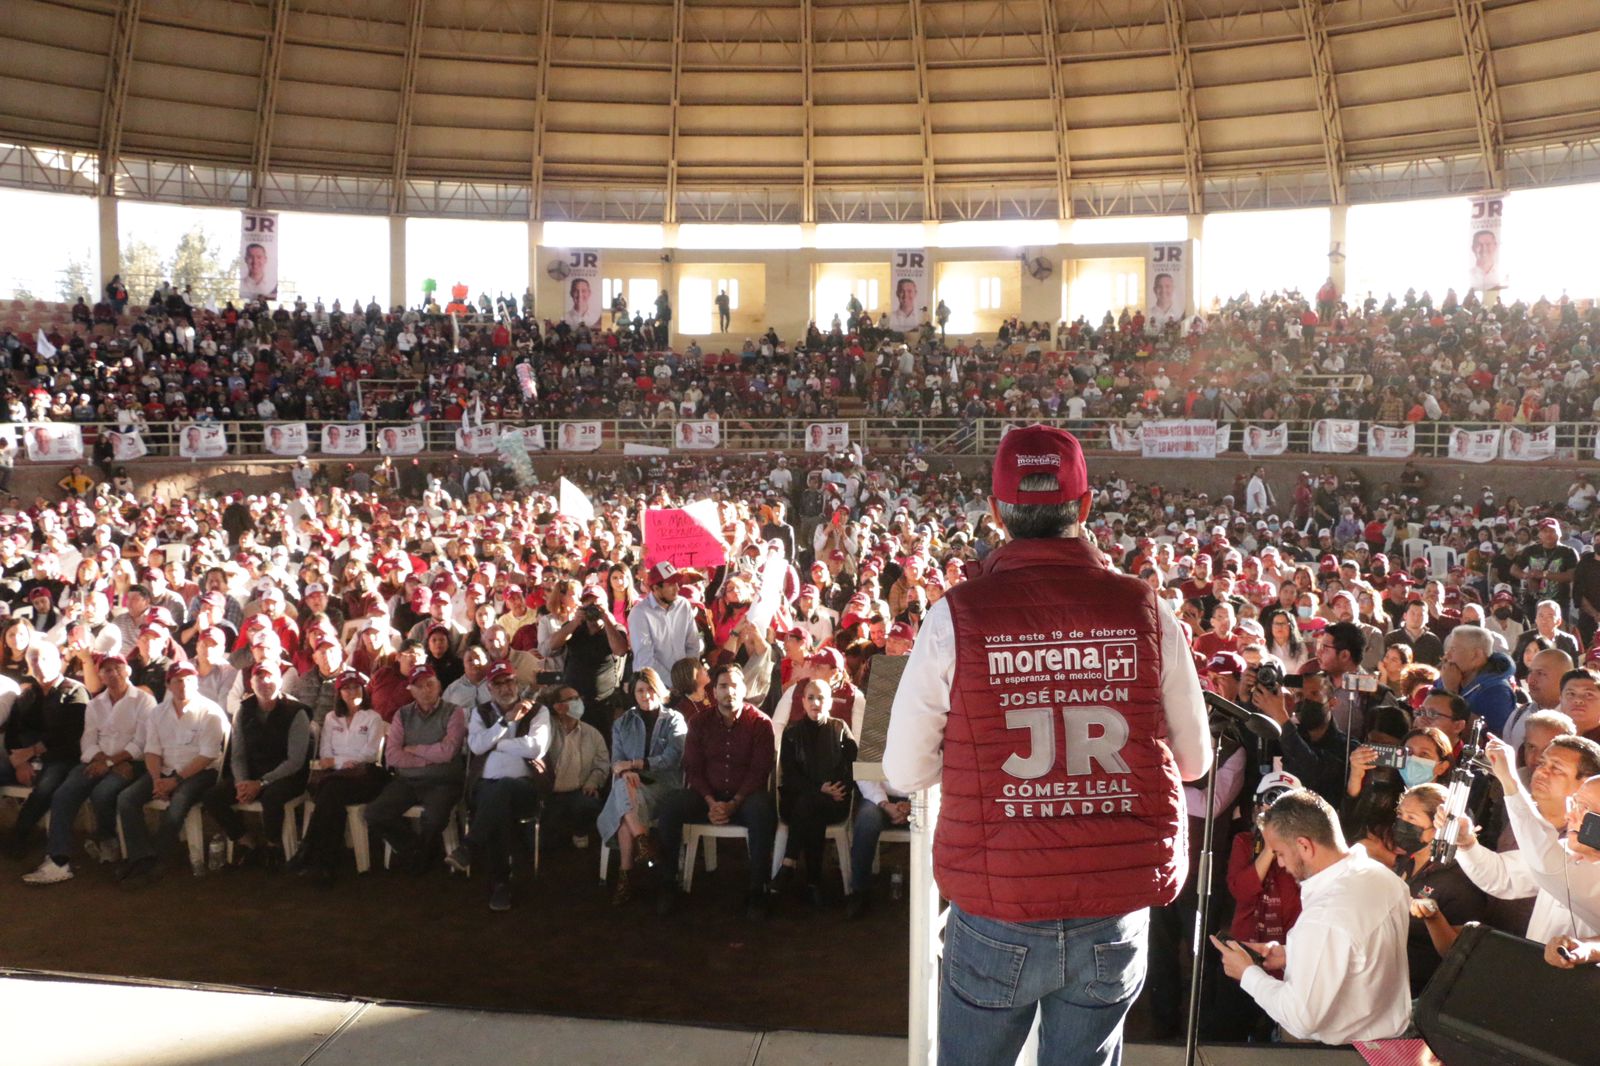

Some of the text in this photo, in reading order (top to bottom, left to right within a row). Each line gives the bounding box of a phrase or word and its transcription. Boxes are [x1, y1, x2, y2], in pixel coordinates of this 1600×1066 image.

[1472, 200, 1502, 218] JR
[245, 216, 274, 232] JR
[570, 253, 597, 268] JR
[896, 253, 924, 268] JR
[1153, 246, 1182, 262] JR
[345, 428, 360, 438] JR
[477, 428, 492, 437] JR
[581, 425, 596, 434] JR
[697, 425, 712, 434] JR
[827, 427, 842, 435] JR
[1530, 432, 1549, 441] JR
[1476, 434, 1495, 444] JR
[985, 628, 1136, 643] vota este 19 de febrero
[989, 648, 1102, 675] morena
[1108, 658, 1133, 677] PT
[990, 671, 1102, 685] La esperanza de mexico
[999, 685, 1129, 706] JOSÉ RAMÓN
[1001, 705, 1132, 780] JR
[1003, 779, 1132, 797] GÓMEZ LEAL
[1004, 800, 1132, 817] SENADOR
